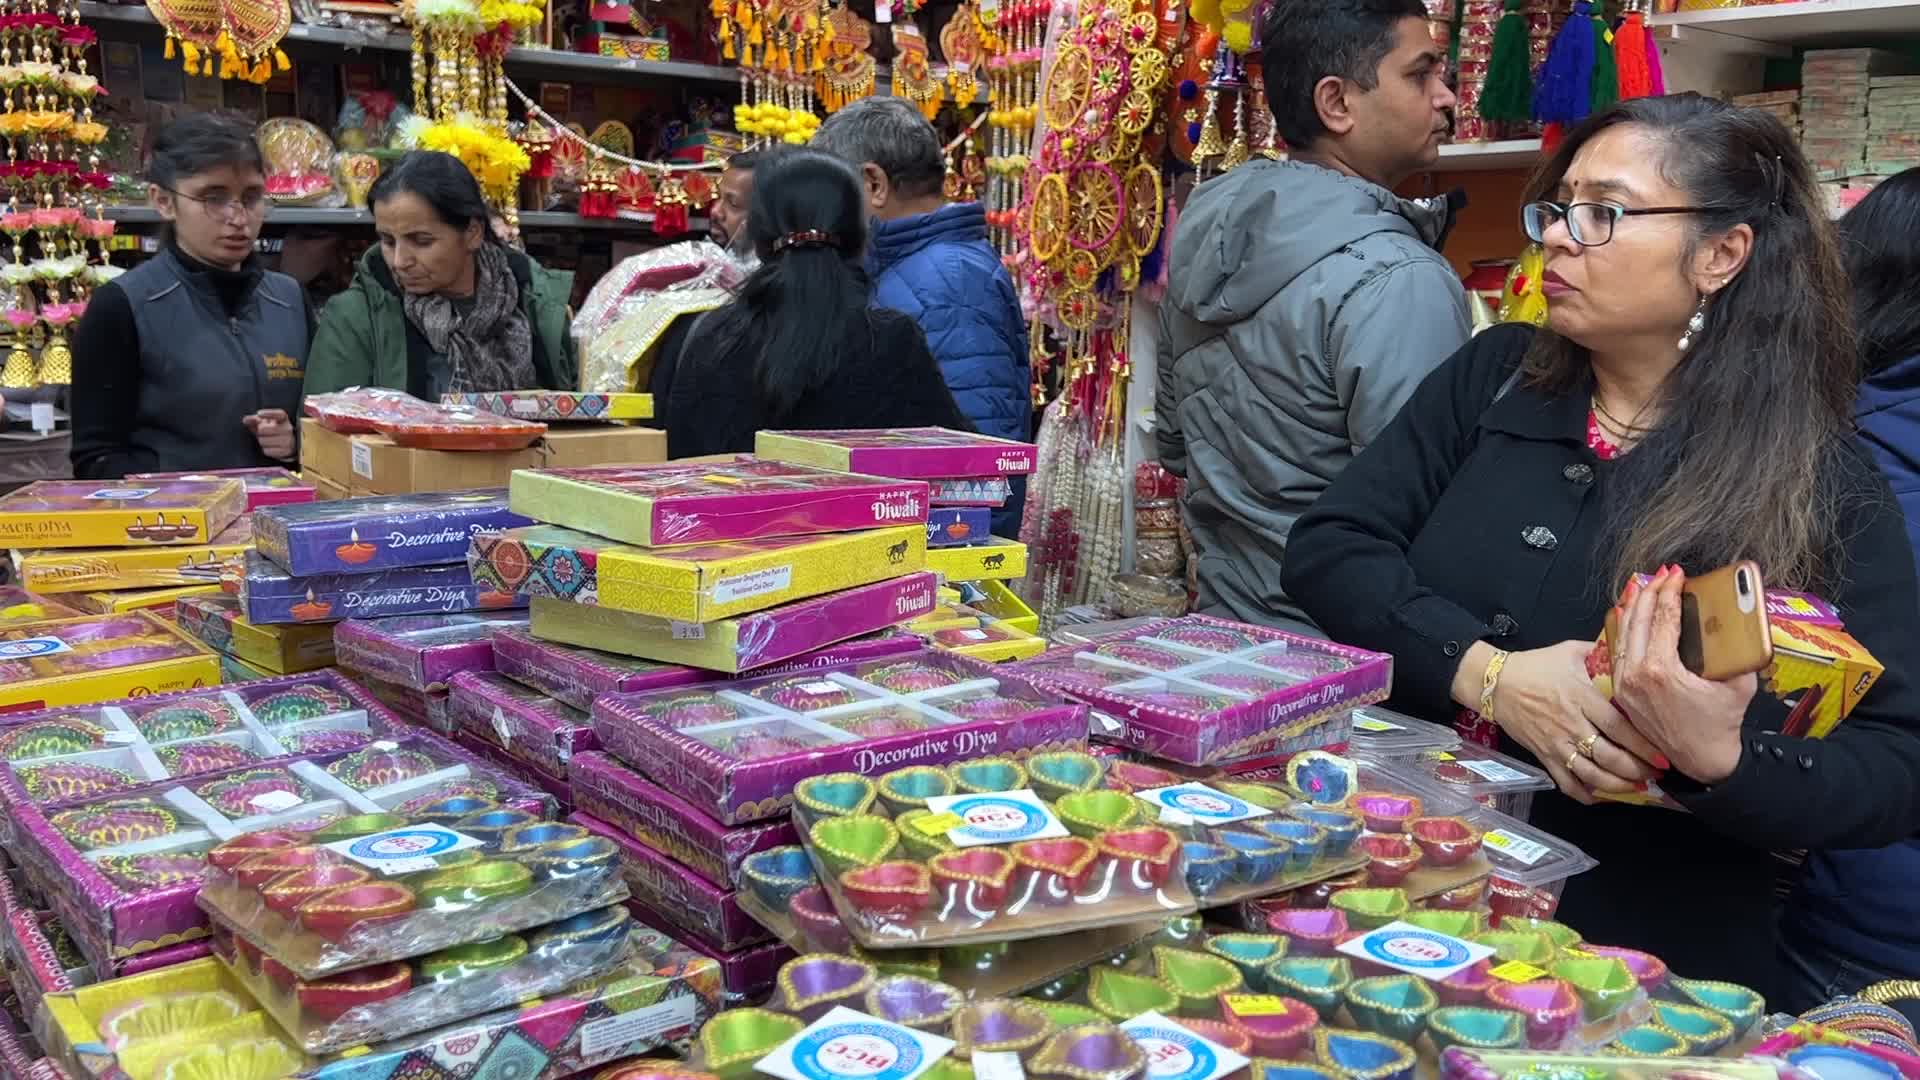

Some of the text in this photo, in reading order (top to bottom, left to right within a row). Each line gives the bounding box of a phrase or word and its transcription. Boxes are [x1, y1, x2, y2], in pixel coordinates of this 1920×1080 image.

[996, 457, 1030, 471] Diwali
[879, 490, 911, 500] HAPPY
[871, 499, 920, 520] Diwali
[40, 520, 72, 532] DIYA
[924, 520, 941, 540] iya
[385, 527, 465, 548] Decorative
[901, 582, 925, 593] HAPPY
[344, 586, 466, 611] Decorative Diya
[896, 590, 931, 614] Diwali
[1268, 682, 1345, 723] Decorative Diya
[853, 731, 998, 774] Decorative Diya
[826, 1045, 891, 1069] BCC
